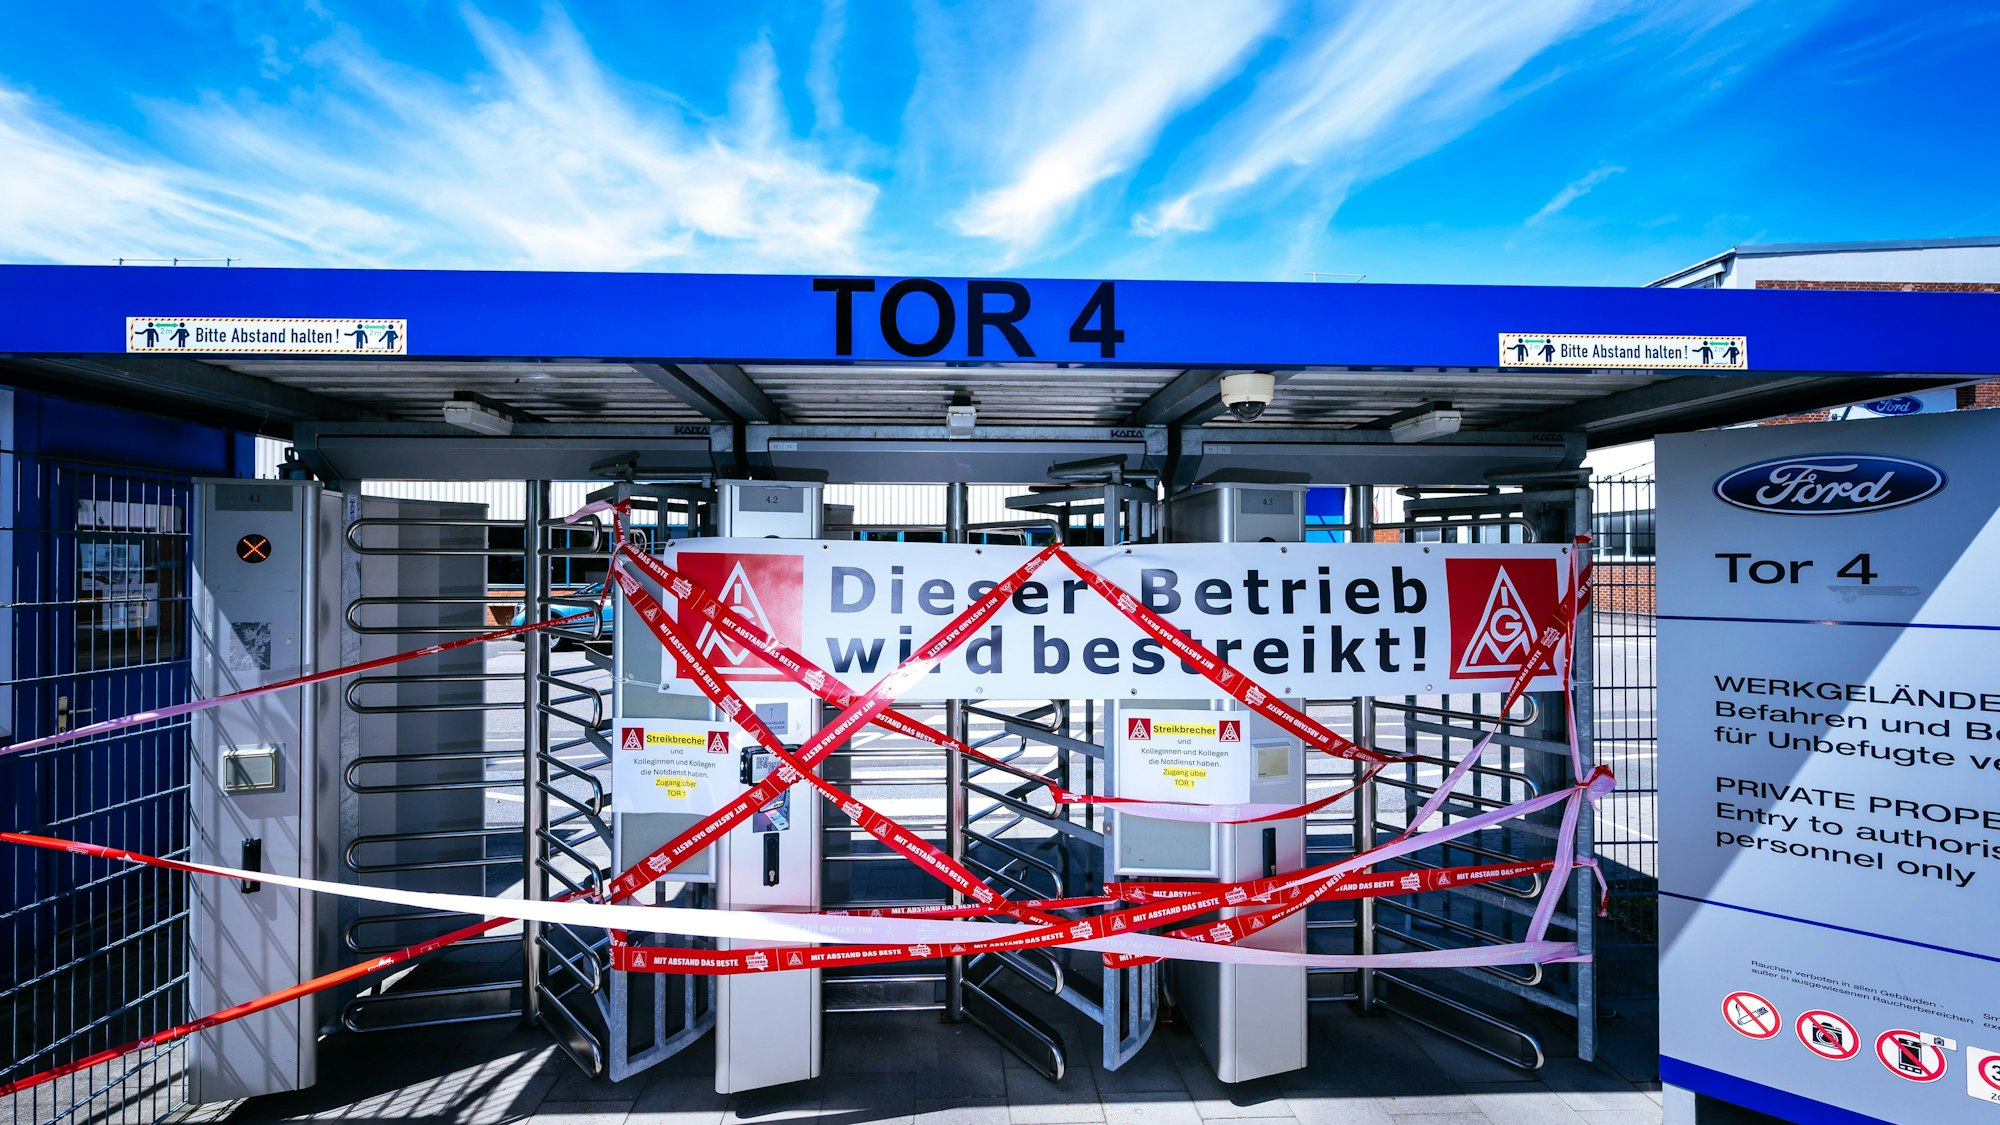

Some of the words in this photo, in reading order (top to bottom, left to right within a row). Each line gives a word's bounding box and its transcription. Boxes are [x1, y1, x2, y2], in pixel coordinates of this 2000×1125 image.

[813, 278, 1036, 357] TOR
[1069, 281, 1124, 358] 4
[196, 327, 226, 343] Bitte
[231, 327, 286, 343] Abstand
[1561, 344, 1588, 358] Bitte
[1592, 344, 1640, 358] Abstand
[1877, 398, 1911, 412] Ford
[1756, 463, 1895, 505] Ford
[765, 495, 778, 504] 4.2
[1262, 498, 1273, 507] 4.3
[637, 551, 650, 565] DAS
[649, 560, 669, 579] BESTE
[1715, 553, 1813, 584] Tor
[1837, 553, 1878, 584] 4
[830, 566, 1088, 616] Dieser
[1141, 566, 1428, 615] Betrieb
[985, 597, 998, 610] MIT
[958, 606, 987, 631] ABSTAND
[1140, 613, 1160, 631] BESTE
[946, 629, 960, 642] DAS
[1159, 628, 1174, 640] DAS
[722, 617, 736, 630] MIT
[735, 627, 766, 650] ABSTAND
[778, 655, 801, 673] BESTE
[826, 625, 1003, 674] wid
[927, 640, 948, 658] BESTE
[1171, 638, 1202, 661] ABSTAND
[659, 623, 673, 637] MIT
[669, 635, 696, 664] ABSTAND
[692, 661, 706, 677] DAS
[702, 674, 721, 695] BESTE
[1200, 658, 1215, 671] MIT
[1519, 667, 1529, 681] DAS
[1527, 650, 1542, 669] BESTE
[1714, 675, 2000, 712] WERKGELÄNDE
[862, 699, 876, 713] MIT
[1266, 703, 1285, 717] BESTE
[834, 711, 863, 735] ABSTAND
[1282, 712, 1294, 723] DAS
[1716, 700, 1867, 730] Befahren
[1882, 718, 1950, 738] und
[1967, 721, 2000, 741] B
[876, 713, 901, 729] BSTAND
[901, 724, 915, 738] DAS
[915, 731, 937, 744] BESTE
[1153, 725, 1216, 735] Streikbrecher
[1293, 719, 1320, 739] ABSTAND
[646, 734, 706, 745] Streikbrecher
[820, 734, 836, 747] DAS
[1317, 734, 1329, 744] MIT
[1714, 726, 1757, 745] für
[1768, 731, 1955, 766] Unbefugte
[802, 744, 823, 763] BESTE
[1141, 748, 1182, 756] Kolleginnen
[1198, 749, 1229, 758] Kollegen
[633, 758, 674, 767] Kolleginnen
[689, 760, 716, 769] Kollegen
[764, 744, 778, 758] MIT
[818, 784, 838, 803] BESTE
[1163, 769, 1189, 777] Zugang
[655, 779, 681, 787] Zugang
[735, 802, 748, 815] MIT
[1717, 777, 1855, 811] PRIVATE
[1870, 796, 2000, 829] PROPE
[705, 810, 735, 833] ABSTAND
[1717, 802, 1799, 832] Entry
[1809, 816, 1843, 835] to
[692, 831, 707, 843] DAS
[672, 840, 693, 856] BESTE
[893, 834, 908, 847] MIT
[906, 841, 936, 865] ABSTAND
[934, 861, 951, 875] DAS
[948, 869, 970, 889] BESTE
[1717, 831, 1883, 870] personnel
[1897, 861, 1976, 888] only
[1457, 872, 1468, 880] MIT
[1470, 870, 1500, 879] ABSTAND
[1359, 881, 1372, 890] DAS
[1373, 880, 1394, 889] BESTE
[1153, 890, 1168, 898] MIT
[1271, 911, 1285, 921] MIT
[1286, 893, 1315, 914] ABSTAND
[1315, 885, 1328, 897] DAS
[1327, 872, 1346, 887] BESTE
[907, 906, 941, 914] ABSTAND
[1132, 915, 1147, 923] MIT
[1148, 907, 1182, 920] ABSTAND
[1182, 903, 1197, 912] DAS
[1197, 897, 1220, 909] BESTE
[1029, 915, 1043, 924] MIT
[989, 939, 1024, 948] ABSTAND
[1025, 936, 1041, 944] DAS
[1041, 932, 1064, 941] BESTE
[653, 956, 668, 965] MIT
[668, 957, 700, 966] ABSTAND
[701, 958, 716, 967] DAS
[716, 958, 739, 967] BESTE
[826, 952, 861, 960] ABSTAND
[879, 949, 902, 957] BESTE
[1119, 953, 1133, 961] MIT
[1751, 960, 1792, 974] Rauchen
[1795, 971, 1839, 985] verboten
[1853, 984, 1877, 994] allen
[1880, 989, 1936, 1007] Gebäuden
[1751, 968, 1778, 978] außer
[1791, 977, 1870, 1000] ausgewiesenen
[1873, 995, 1974, 1024] Raucherbereichen
